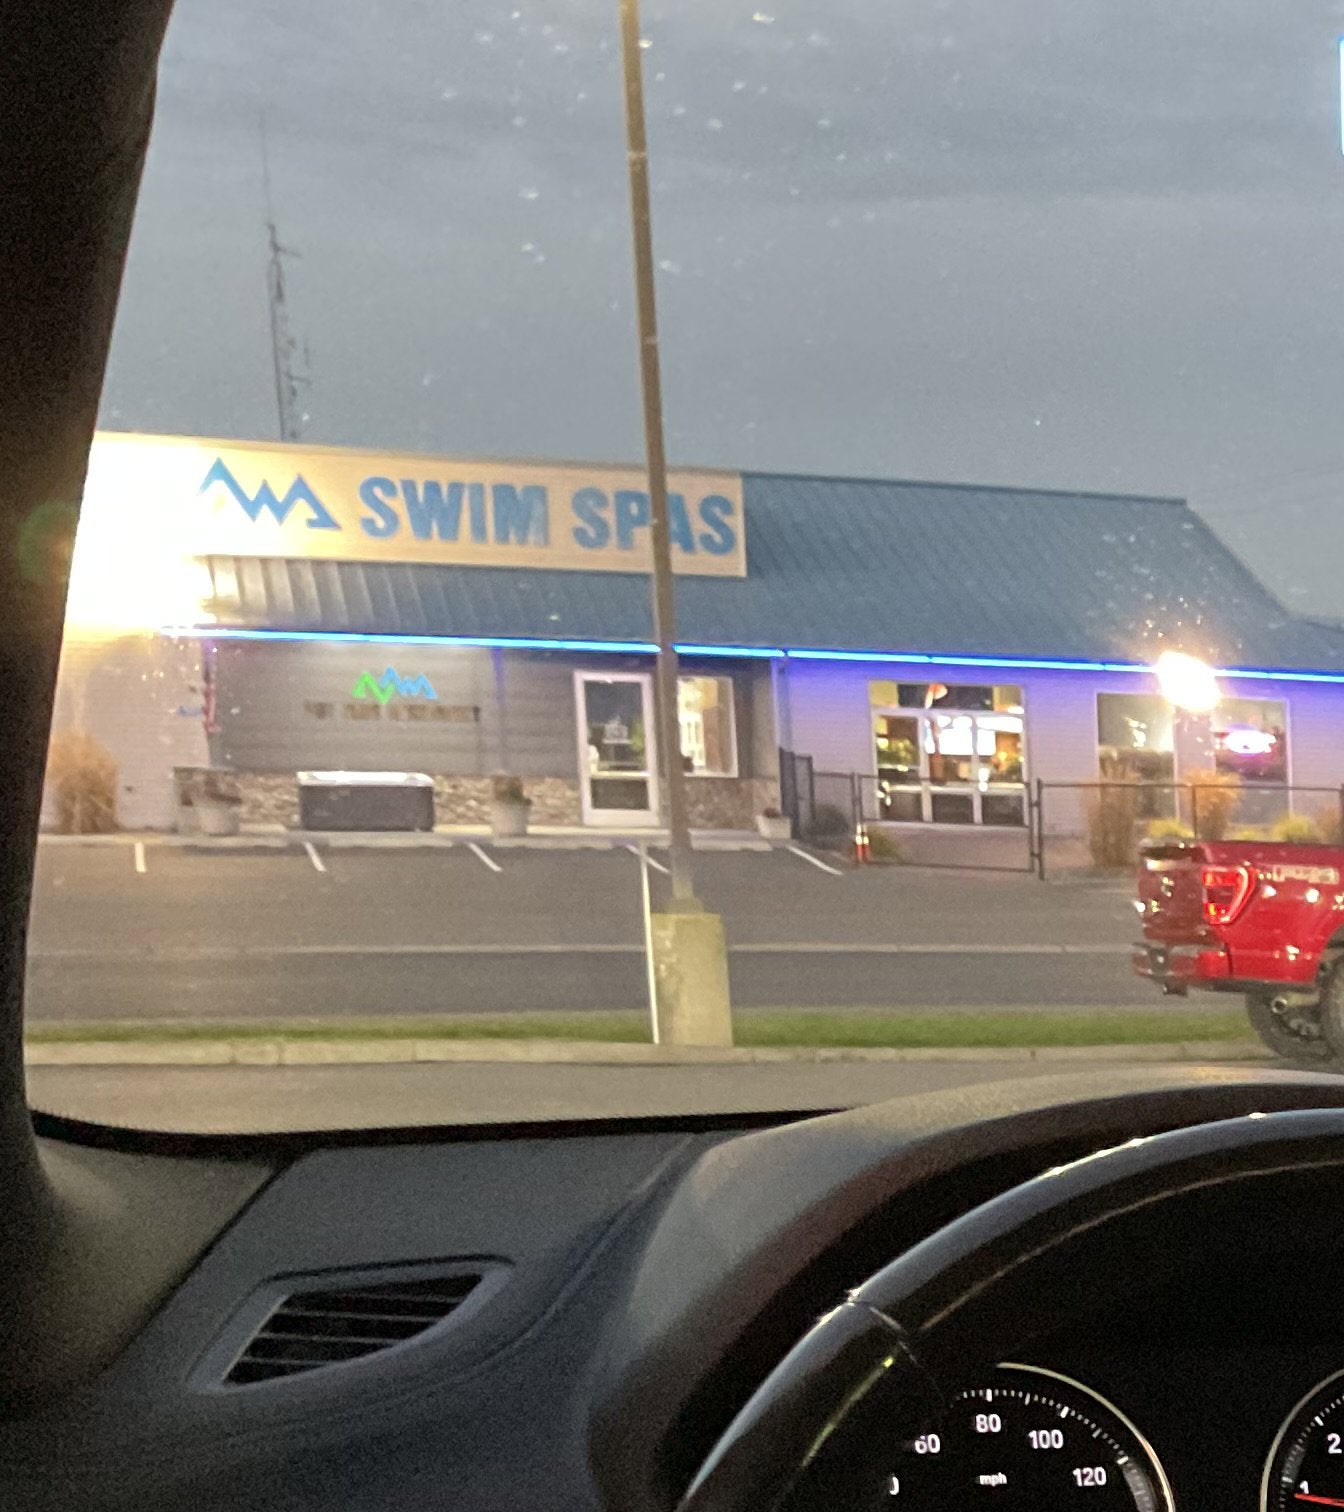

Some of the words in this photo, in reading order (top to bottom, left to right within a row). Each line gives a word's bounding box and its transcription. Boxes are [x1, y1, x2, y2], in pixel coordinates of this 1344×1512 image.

[359, 476, 549, 547] SWIM
[573, 487, 738, 555] SPAS
[975, 1414, 1002, 1433] 80
[914, 1433, 941, 1454] 60
[1028, 1429, 1064, 1450] 100
[1326, 1433, 1343, 1454] 2
[979, 1472, 1008, 1487] mph
[1072, 1466, 1107, 1487] 120
[1299, 1480, 1310, 1495] 1
